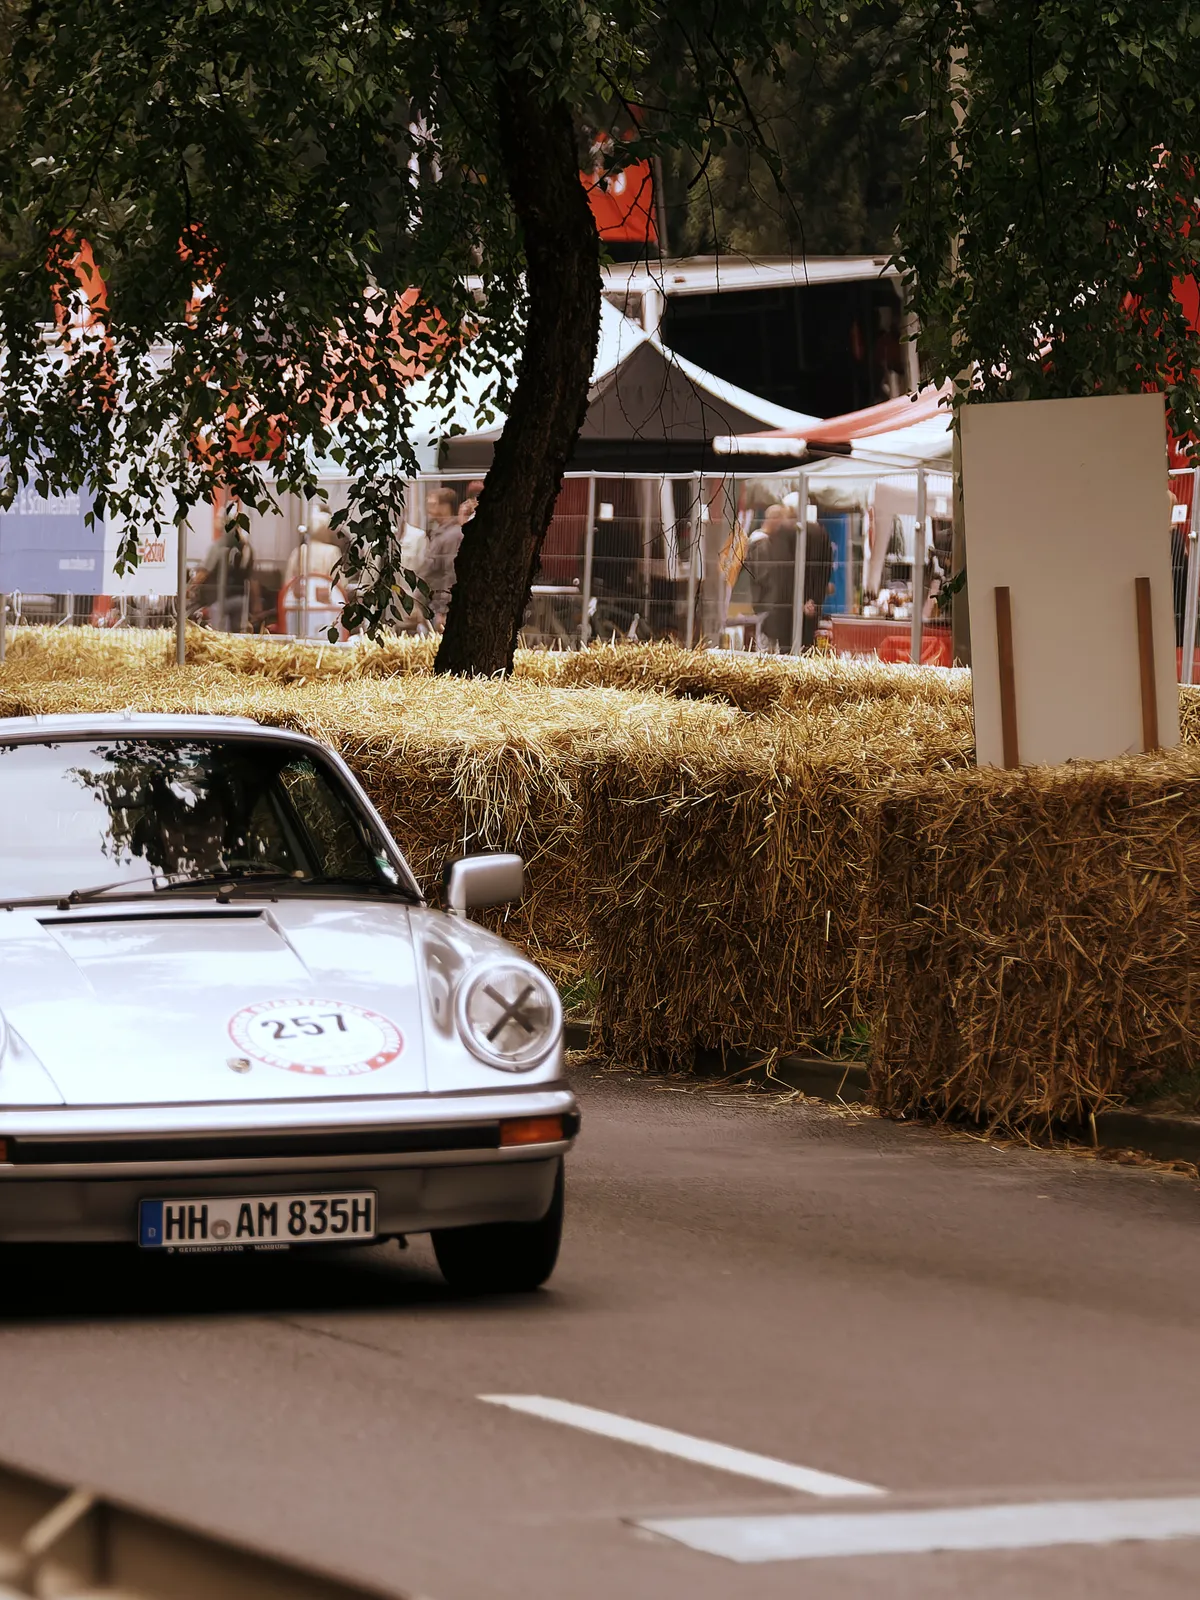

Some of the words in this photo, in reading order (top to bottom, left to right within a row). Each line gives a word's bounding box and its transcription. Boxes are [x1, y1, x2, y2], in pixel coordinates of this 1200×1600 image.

[260, 1012, 348, 1040] 257
[165, 1205, 209, 1240] HH
[235, 1202, 278, 1238] AM
[287, 1198, 372, 1237] 835H
